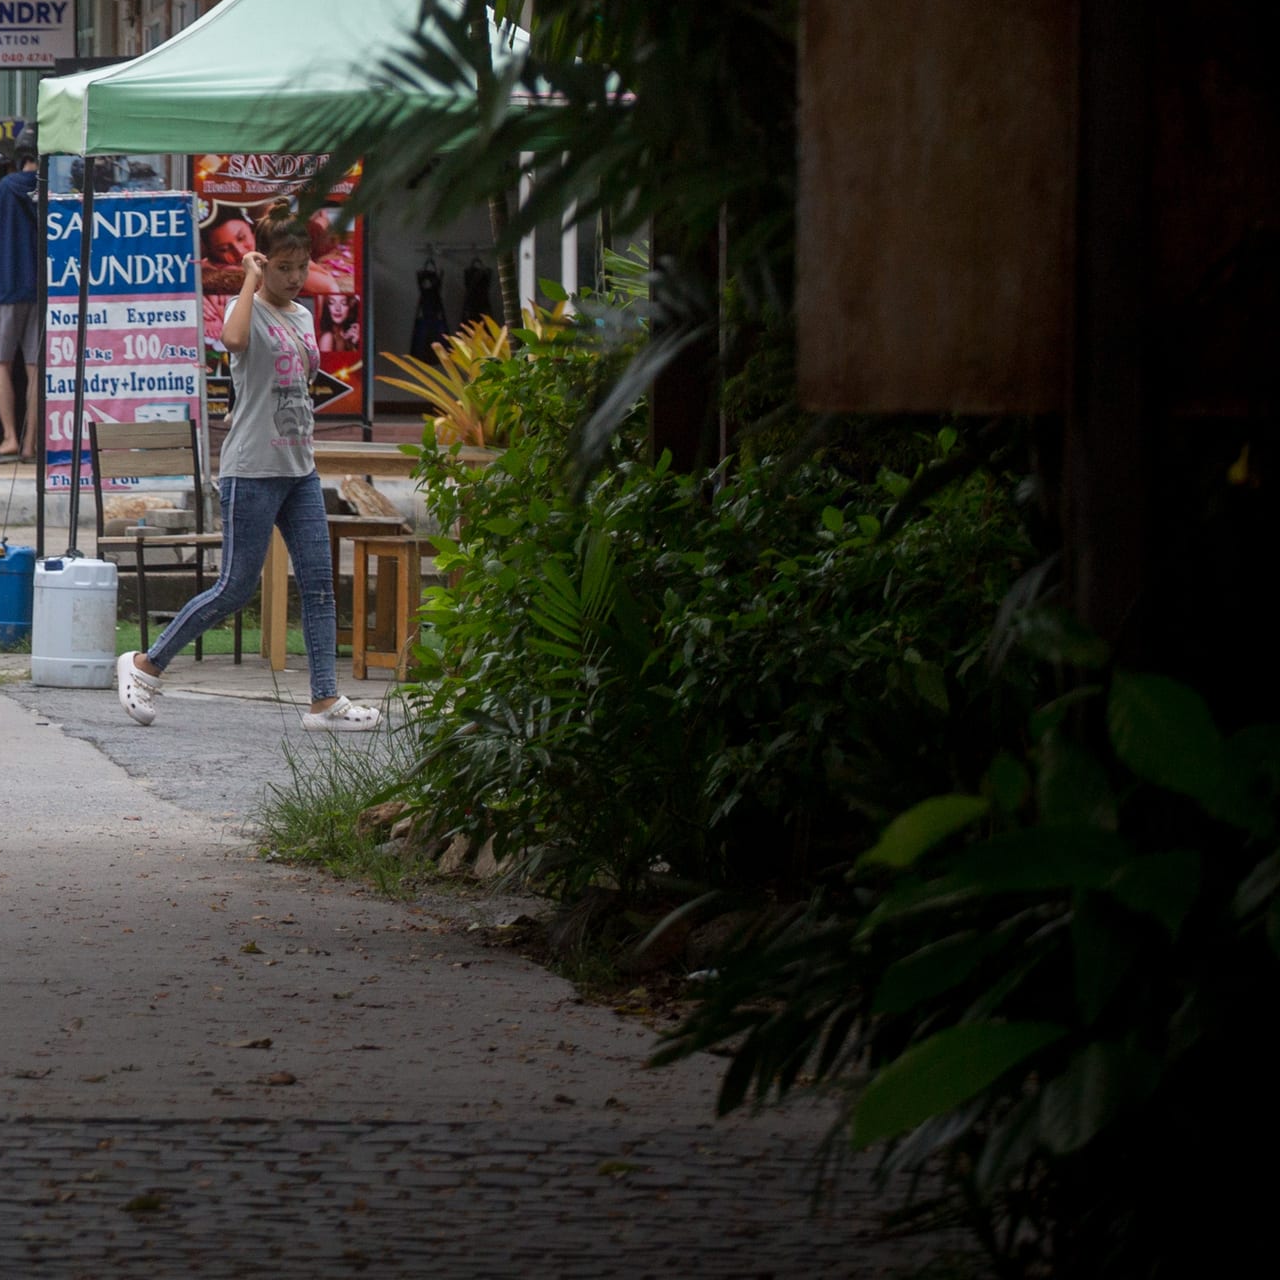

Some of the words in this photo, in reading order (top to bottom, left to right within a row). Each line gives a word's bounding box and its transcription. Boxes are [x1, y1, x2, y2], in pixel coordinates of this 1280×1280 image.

[47, 209, 187, 241] SANDEE
[47, 253, 191, 287] LAUNDRY
[127, 308, 187, 326] Express
[49, 474, 97, 487] Thn
